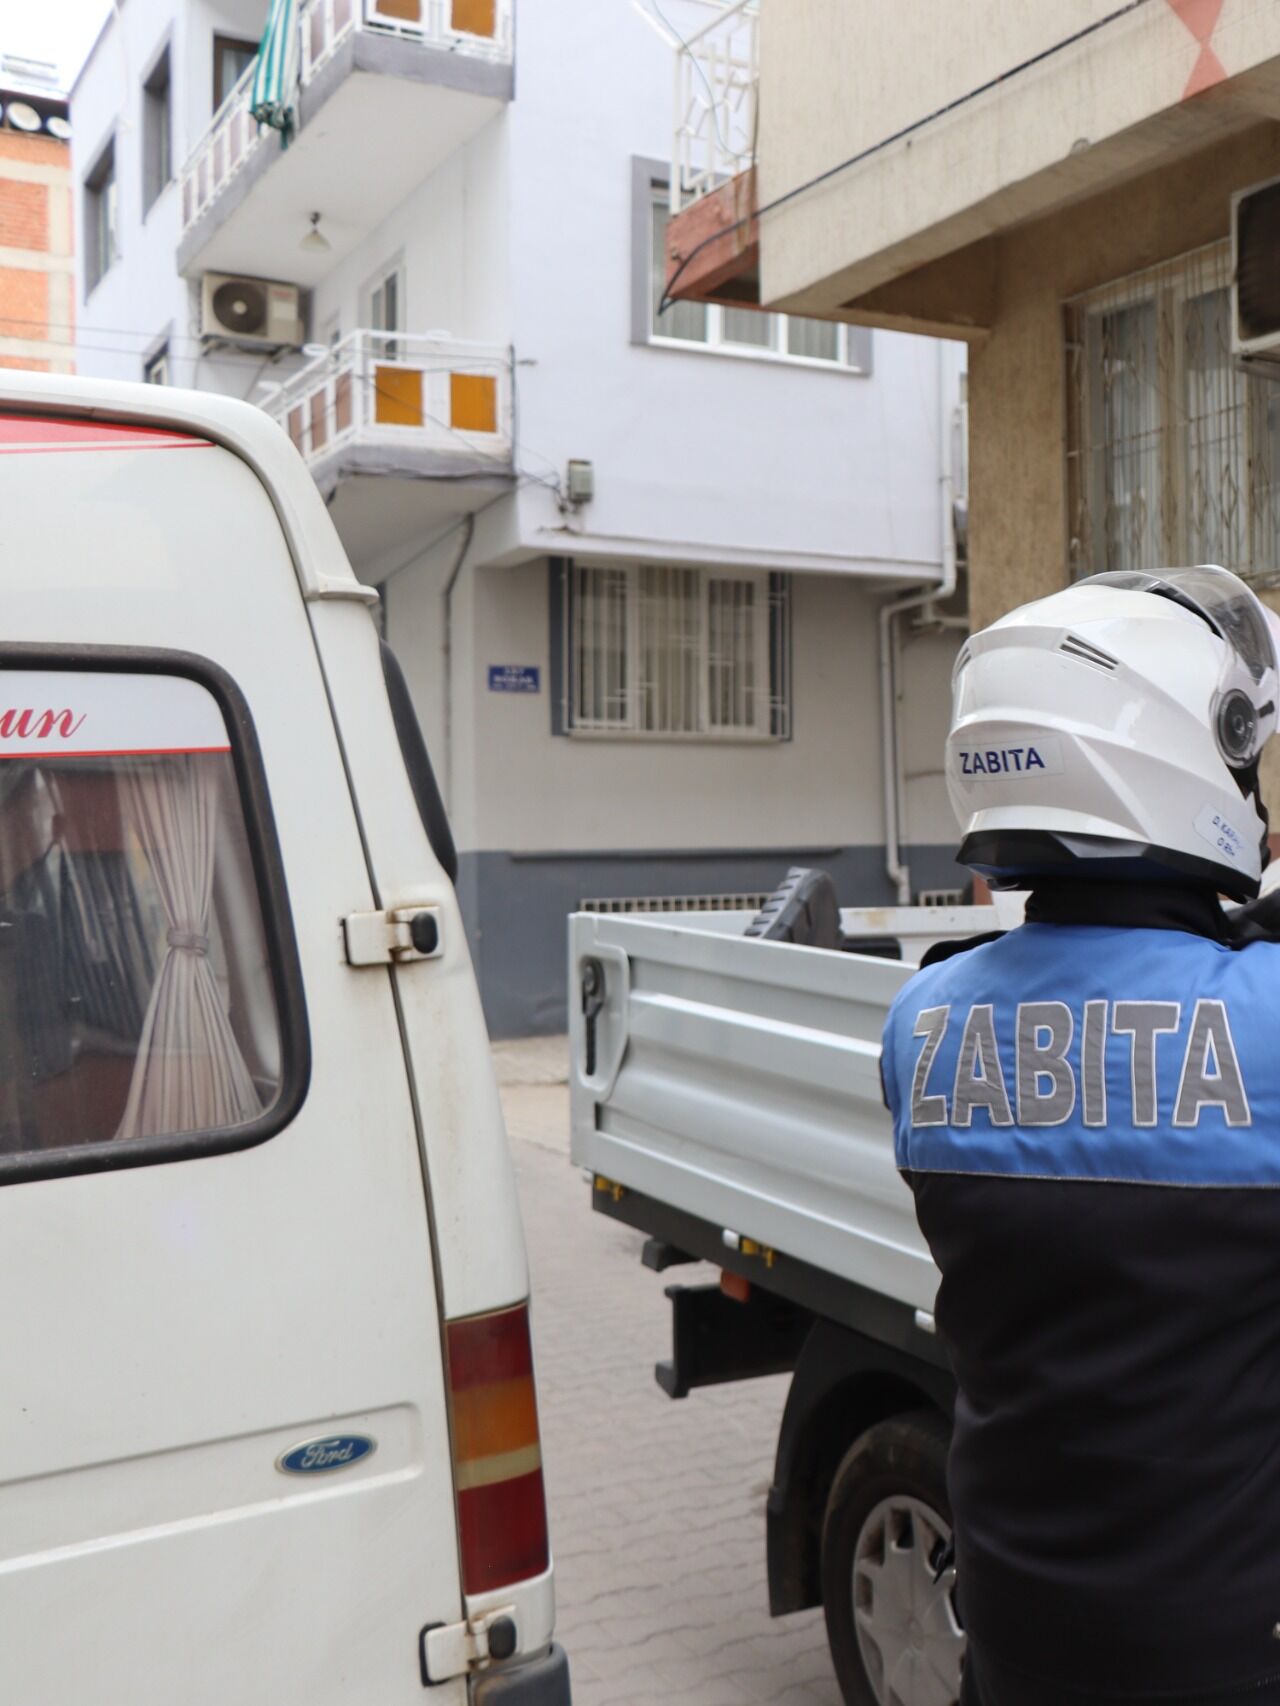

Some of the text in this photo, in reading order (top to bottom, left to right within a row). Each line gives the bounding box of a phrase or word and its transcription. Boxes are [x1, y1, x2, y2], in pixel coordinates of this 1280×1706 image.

[959, 747, 1045, 775] ZABITA
[911, 999, 1252, 1128] ZABITA
[301, 1440, 354, 1468] Ford
